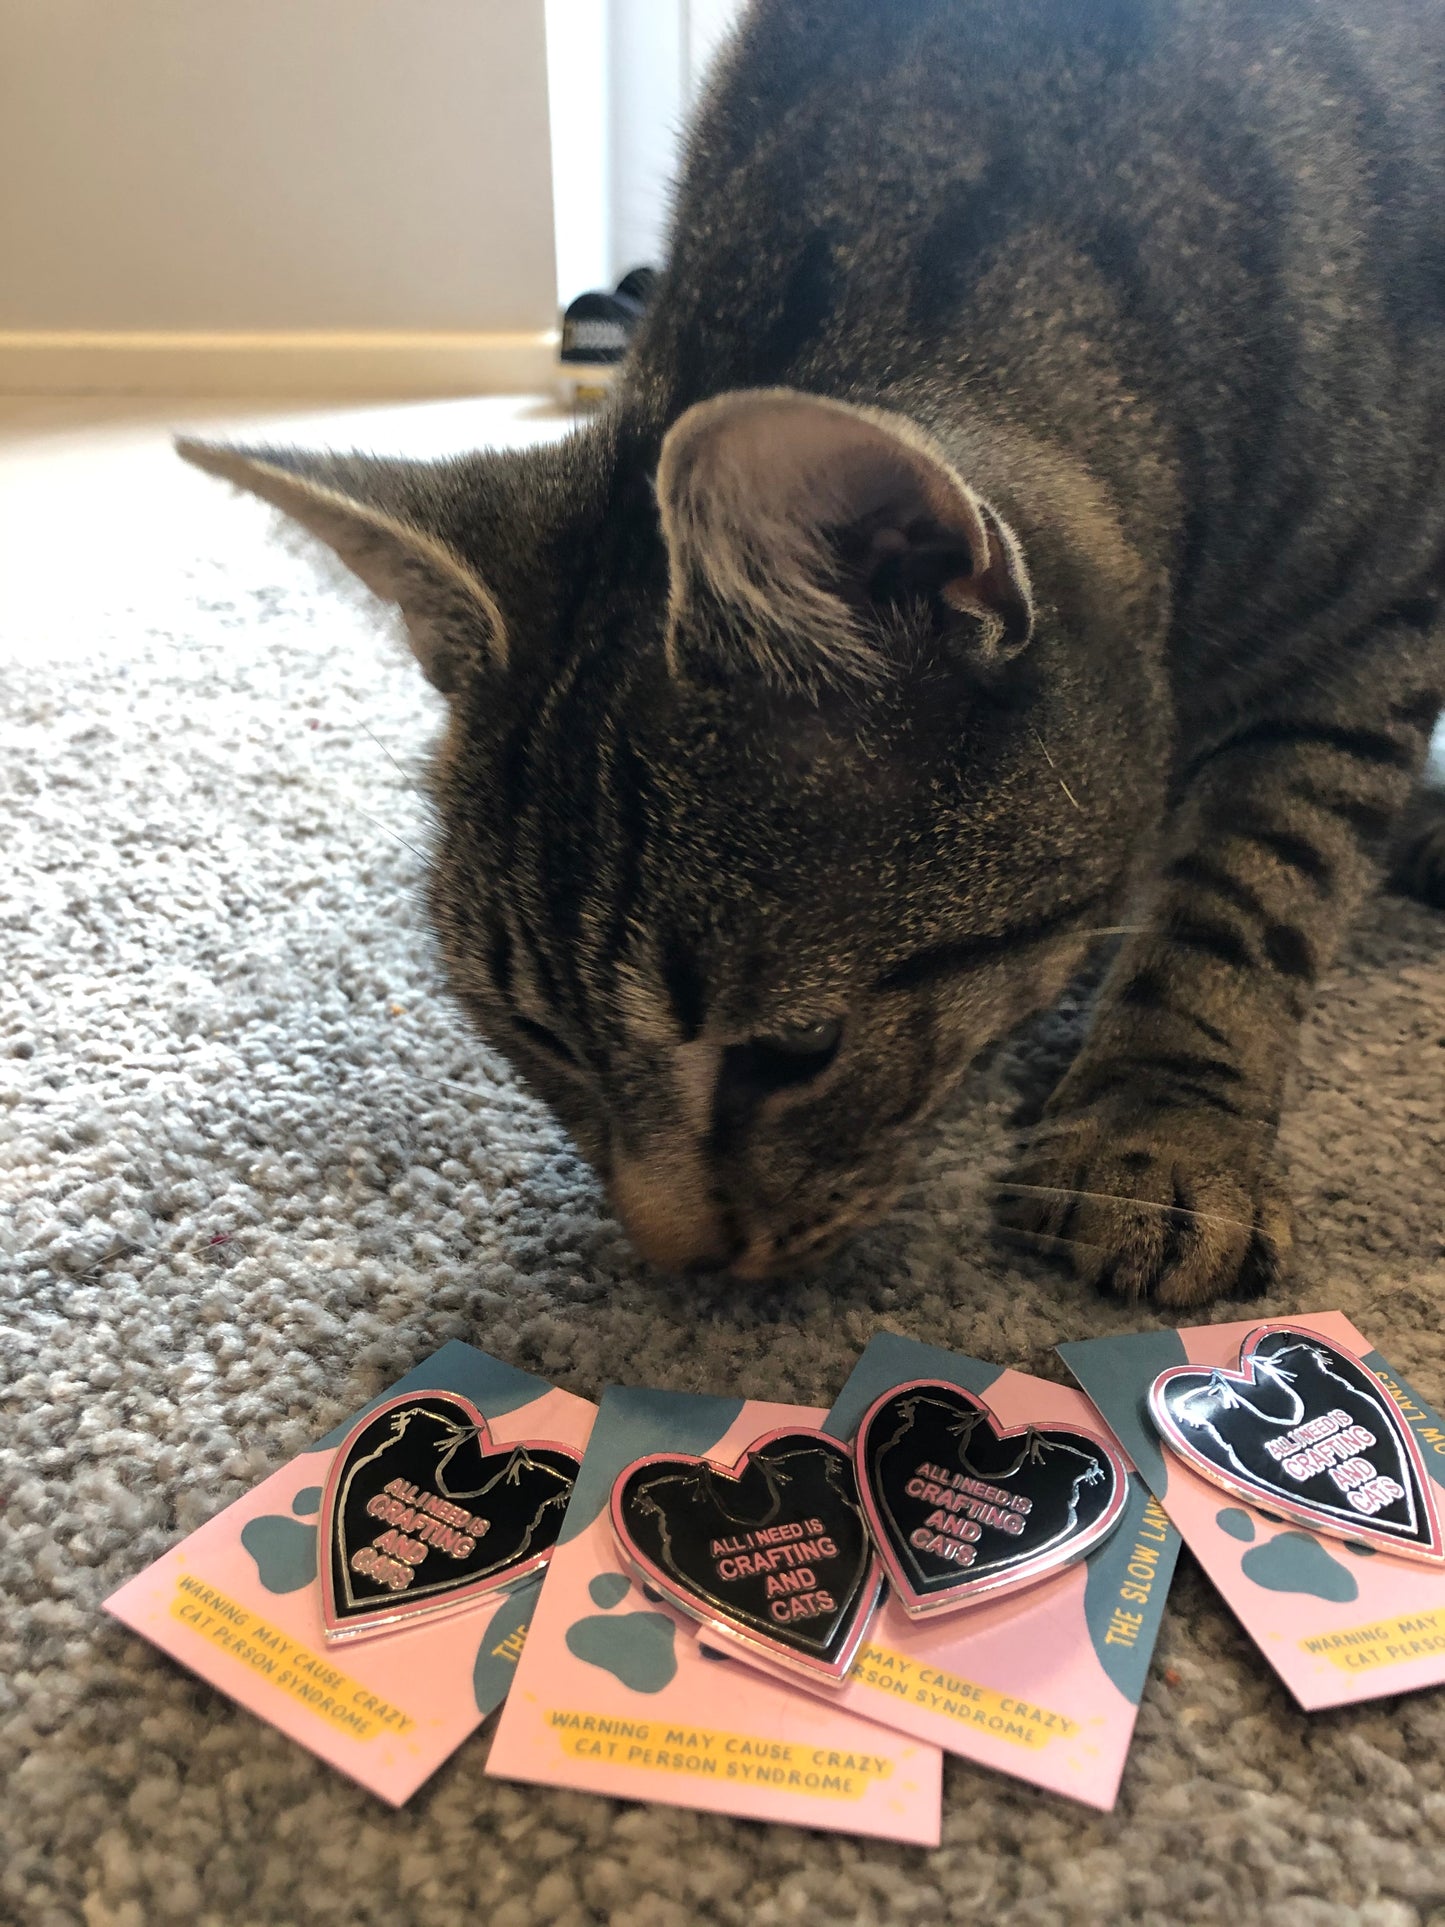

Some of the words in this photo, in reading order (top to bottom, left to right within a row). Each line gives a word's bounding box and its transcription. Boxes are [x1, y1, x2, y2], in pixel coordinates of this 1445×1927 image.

[1301, 1416, 1339, 1444] NEED
[1329, 1410, 1352, 1427] IS
[1283, 1426, 1375, 1481] CRAFTING
[1330, 1458, 1376, 1491] AND
[384, 1478, 418, 1503] ALL
[424, 1496, 471, 1528] NEED
[467, 1517, 490, 1537] IS
[905, 1478, 1026, 1534] CRAFTING
[916, 1462, 949, 1485] ALL
[961, 1478, 1011, 1505] NEED
[1011, 1495, 1032, 1514] IS
[1348, 1477, 1404, 1513] CATS
[367, 1494, 475, 1558] CRAFTING
[711, 1537, 746, 1555] ALL
[755, 1523, 804, 1545] NEED
[804, 1518, 825, 1534] IS
[925, 1510, 981, 1541] AND
[1139, 1494, 1169, 1541] LAN
[373, 1529, 428, 1564] AND
[718, 1537, 838, 1579] CRAFTING
[911, 1528, 977, 1566] CATS
[352, 1547, 415, 1589] CATS
[766, 1568, 817, 1596] AND
[1120, 1543, 1160, 1605] SLOW
[771, 1590, 836, 1621] CATS
[1104, 1607, 1143, 1648] THE
[1304, 1627, 1390, 1653] WARNING
[1398, 1616, 1439, 1635] MAY
[179, 1604, 214, 1630] CAT
[213, 1627, 278, 1674] PERSON
[279, 1670, 374, 1736] SYNDROME
[180, 1575, 248, 1628] WARNING
[253, 1626, 290, 1656] MAY
[294, 1652, 346, 1690] CAUSE
[353, 1690, 412, 1731] CRAZY
[1345, 1648, 1381, 1667] CAT
[1386, 1636, 1445, 1658] PERSO
[851, 1663, 909, 1695] RSON
[915, 1688, 1035, 1742] SYNDROME
[863, 1648, 912, 1674] MAY
[919, 1669, 984, 1702] CAUSE
[1000, 1698, 1073, 1732] CRAZY
[551, 1710, 650, 1740] WARNING
[665, 1730, 715, 1751] MAY
[725, 1739, 793, 1762] CAUSE
[812, 1750, 887, 1773] CRAZY
[575, 1738, 619, 1757] CAT
[628, 1745, 717, 1773] PERSON
[726, 1762, 853, 1793] SYNDROME
